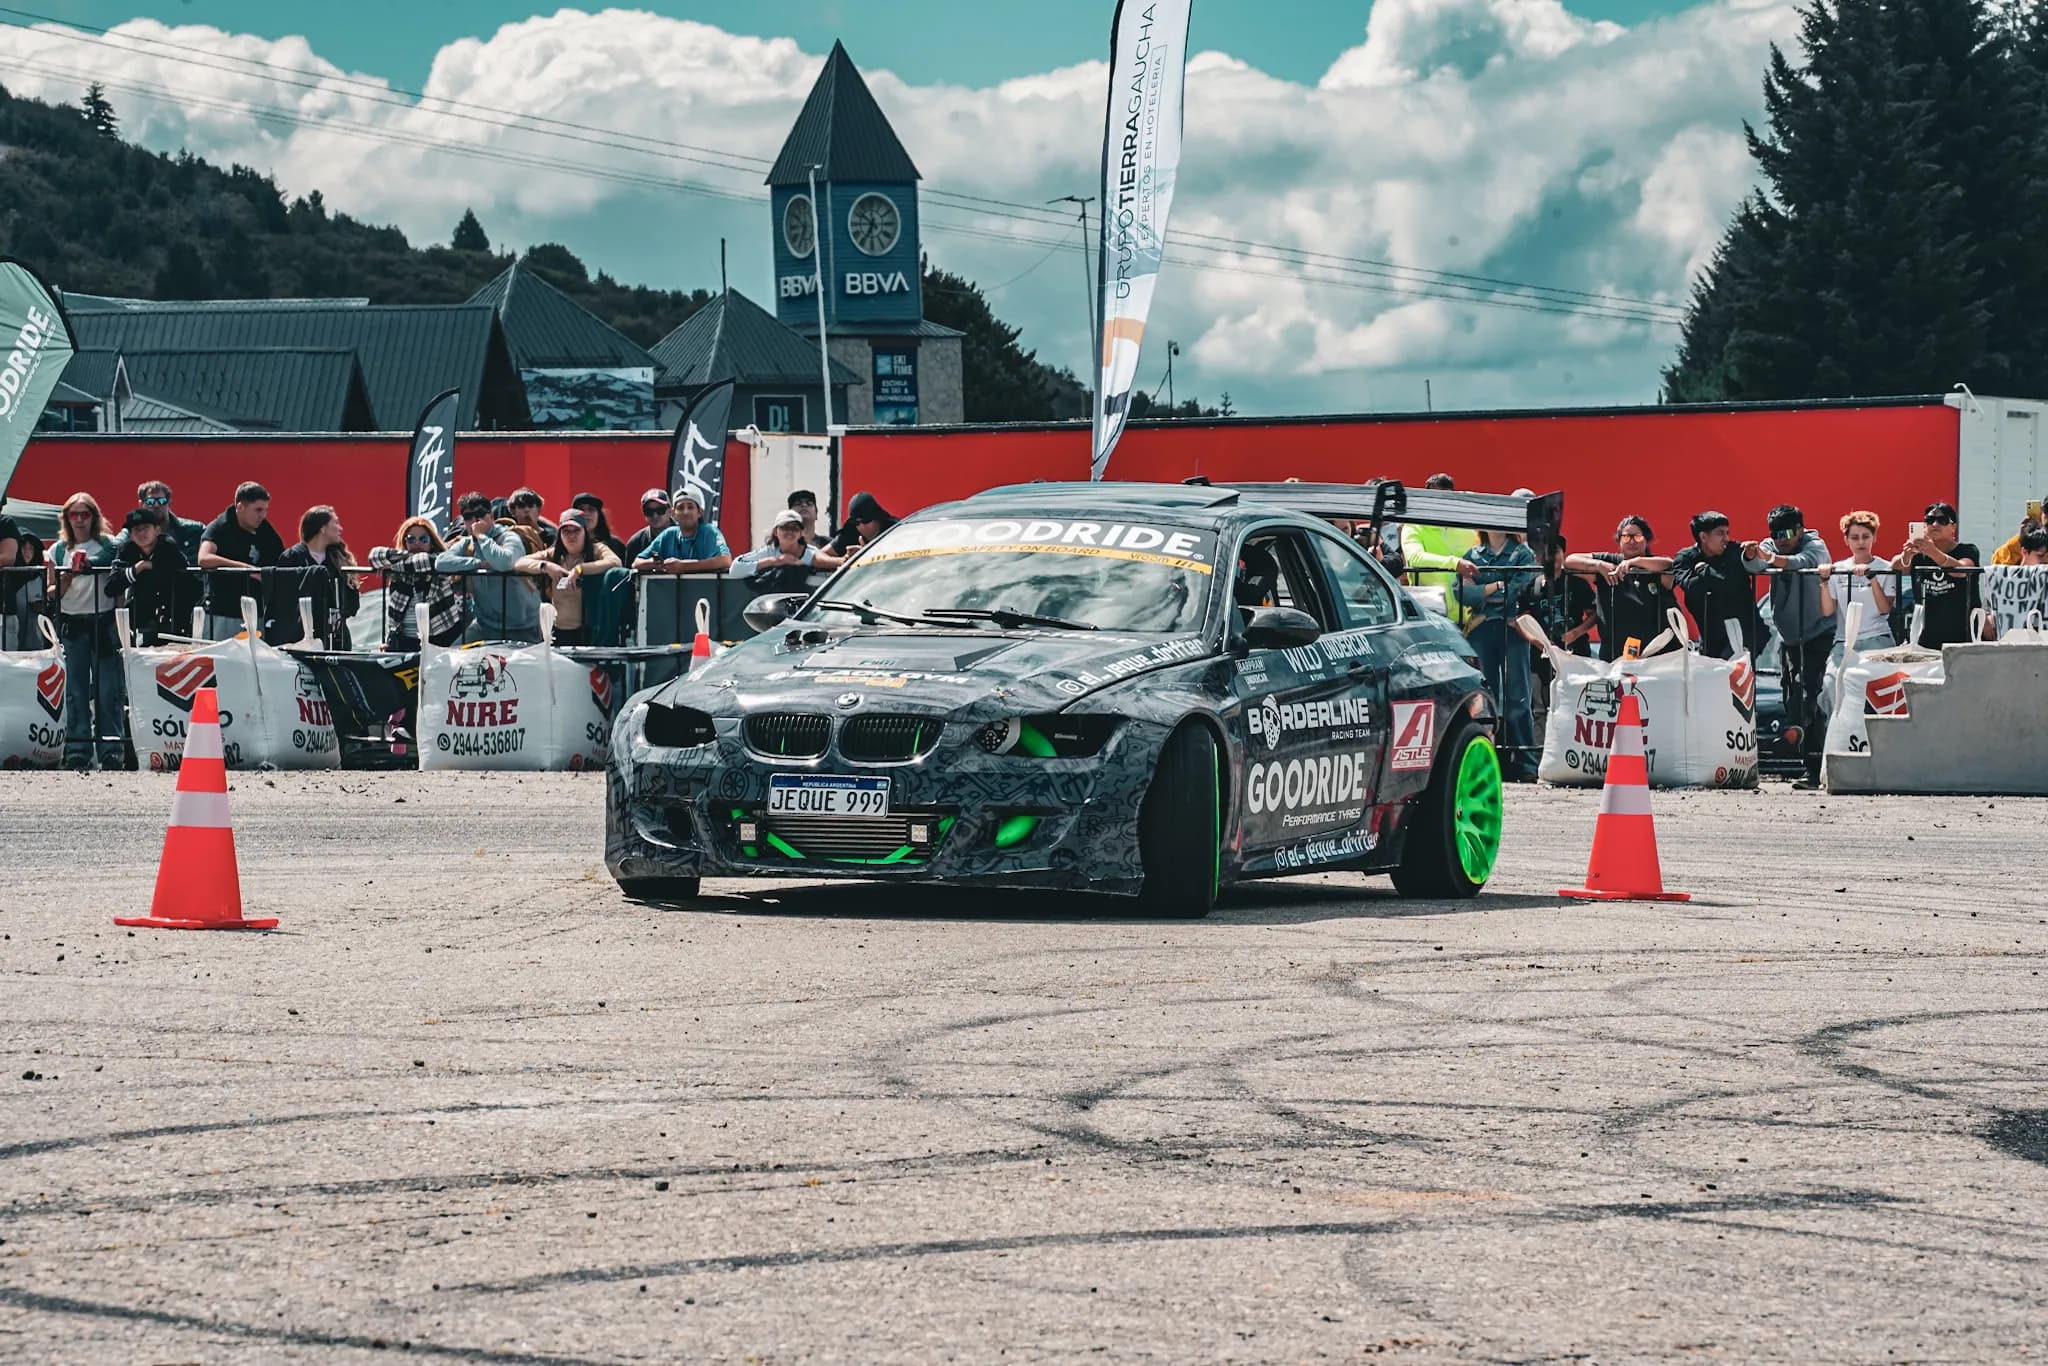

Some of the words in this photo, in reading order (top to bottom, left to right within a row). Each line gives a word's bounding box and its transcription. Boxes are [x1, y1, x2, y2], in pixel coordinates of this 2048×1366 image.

[1115, 3, 1156, 299] GRUPOTIERRAGAUCHA
[1145, 141, 1153, 160] EN
[1142, 164, 1152, 241] EXPERTOS
[845, 273, 910, 294] BBVA
[1281, 644, 1323, 673] WILD
[1320, 633, 1375, 660] UNDERCAR
[152, 710, 233, 737] SÓLO
[296, 697, 332, 726] NIR
[446, 699, 519, 727] NIRE
[28, 723, 67, 748] SÓLID
[453, 728, 525, 756] 2944-536807
[1331, 730, 1354, 740] RACING
[1355, 728, 1371, 738] TEAM
[1726, 726, 1757, 752] SÓLID
[1247, 752, 1366, 814] GOODRIDE
[771, 789, 837, 811] JEQUE
[846, 791, 883, 813] 999
[1282, 814, 1336, 827] PERFORMANCE
[1338, 807, 1361, 819] TYRES
